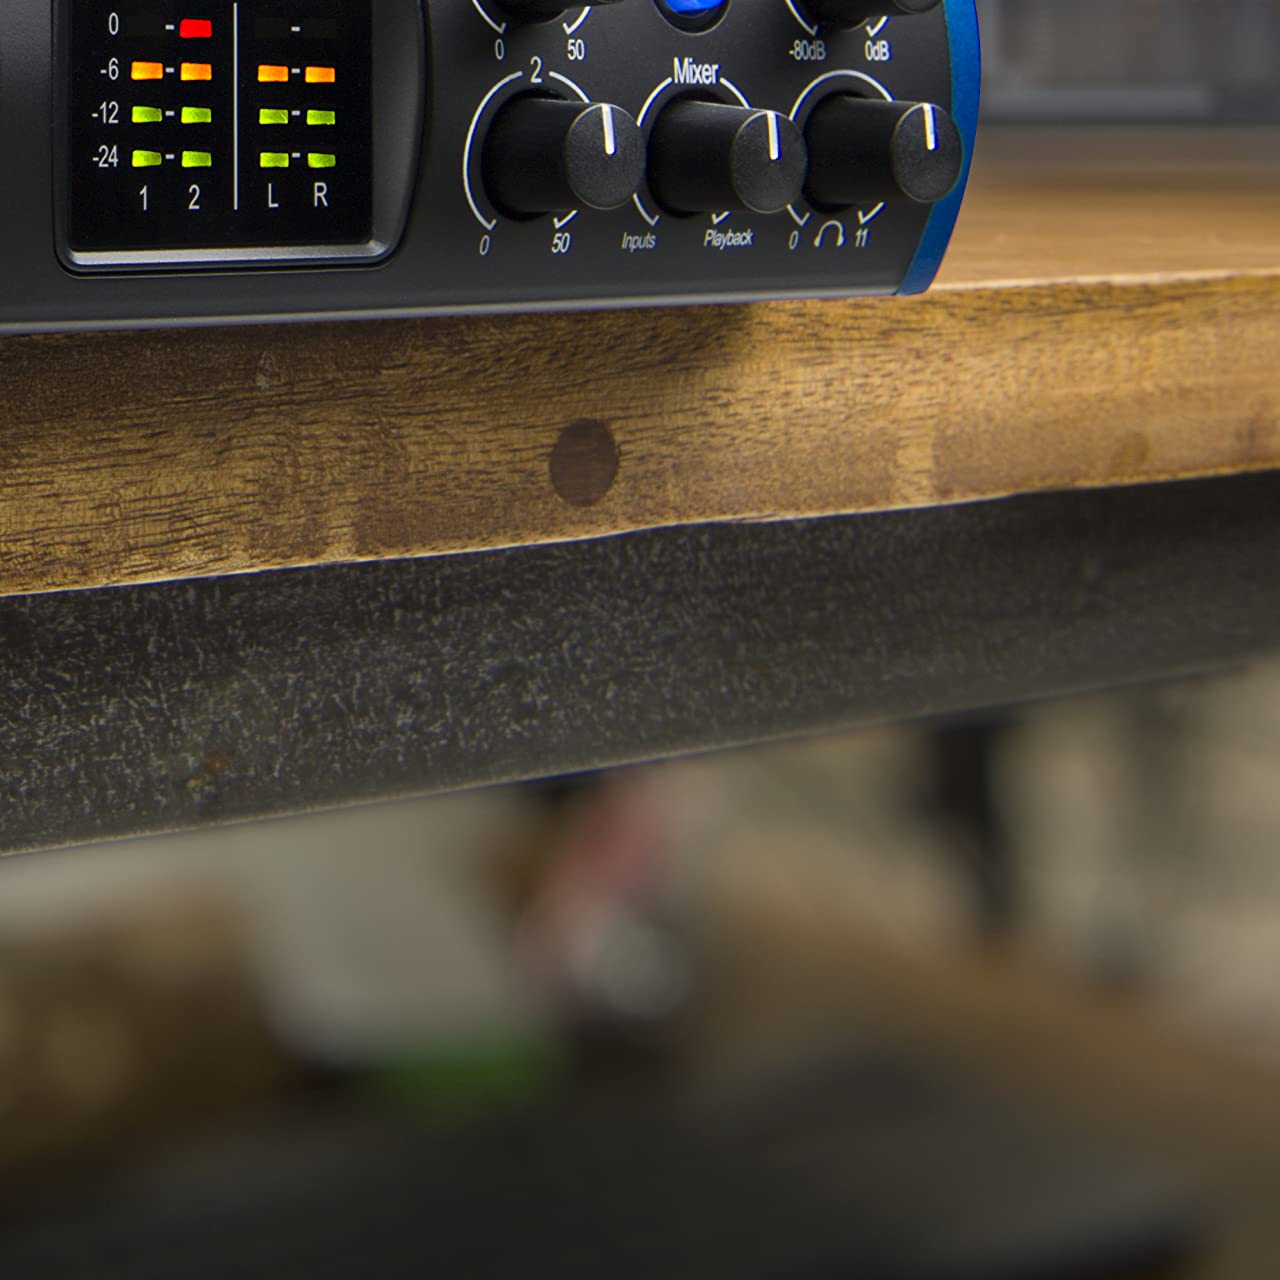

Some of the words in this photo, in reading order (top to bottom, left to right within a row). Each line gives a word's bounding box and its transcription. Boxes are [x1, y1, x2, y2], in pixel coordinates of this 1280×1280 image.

[108, 12, 119, 36] 0
[494, 38, 505, 61] 0
[566, 38, 586, 61] 50
[788, 39, 826, 62] -80dB
[863, 39, 891, 62] 0dB
[100, 57, 119, 82] -6
[529, 55, 544, 84] 2
[672, 56, 720, 86] Mixer
[91, 100, 119, 124] -12
[91, 144, 119, 169] -24
[139, 185, 148, 211] 1
[187, 184, 201, 210] 2
[268, 183, 279, 208] L
[313, 182, 328, 207] R
[479, 234, 491, 256] 0
[551, 232, 571, 254] 50
[621, 231, 657, 253] Inputs
[703, 228, 754, 251] Playback
[788, 230, 800, 251] 0
[854, 227, 869, 248] 11
